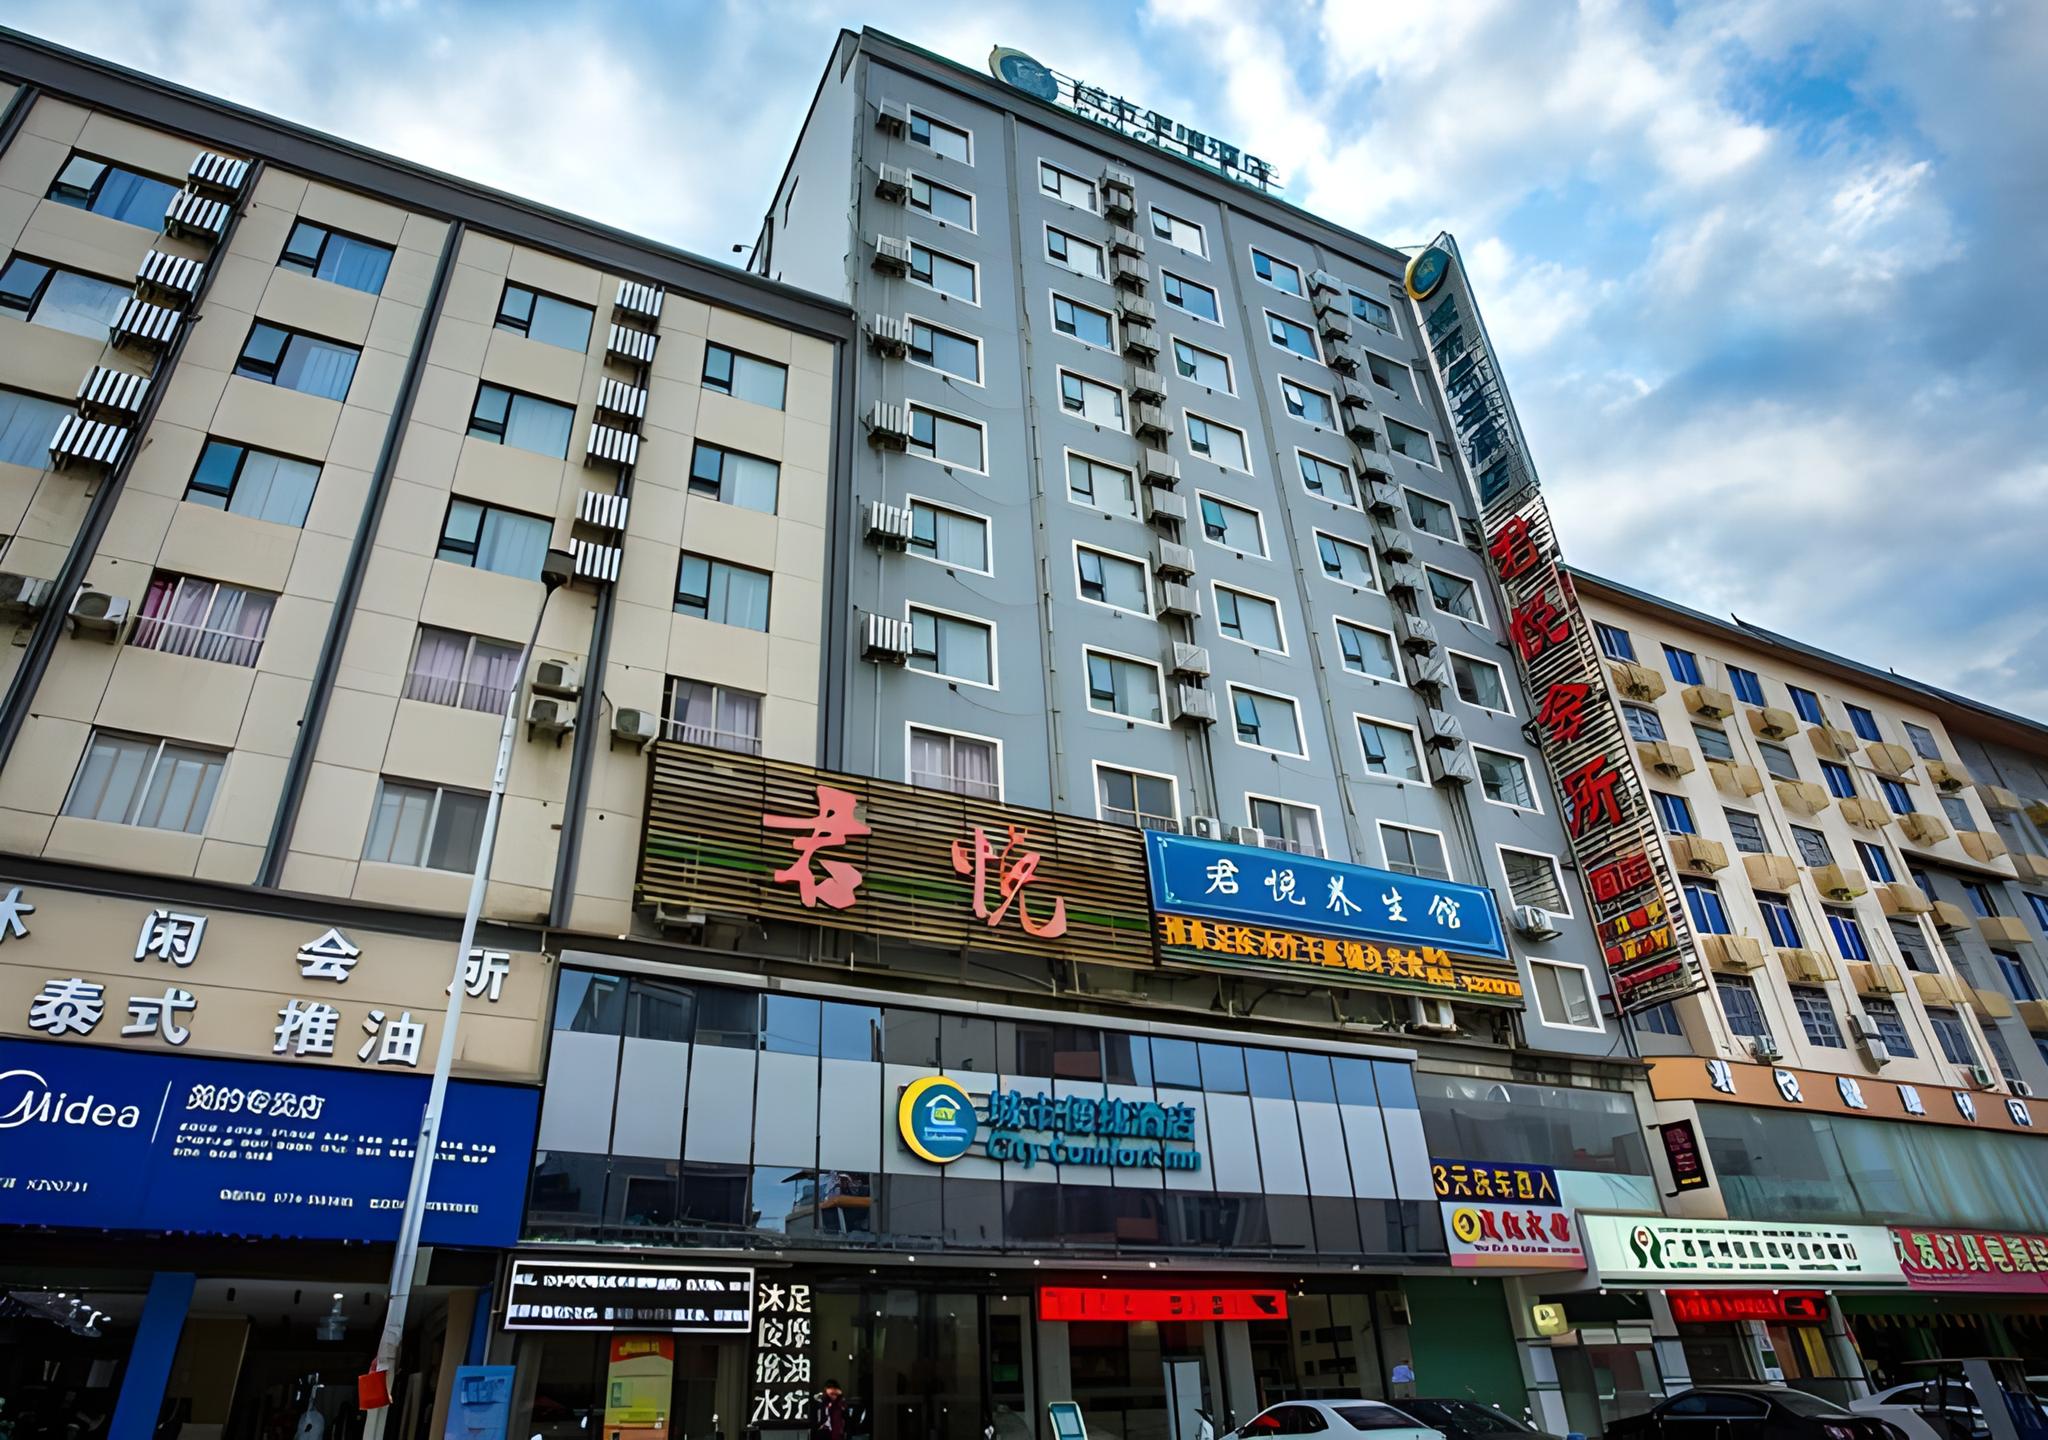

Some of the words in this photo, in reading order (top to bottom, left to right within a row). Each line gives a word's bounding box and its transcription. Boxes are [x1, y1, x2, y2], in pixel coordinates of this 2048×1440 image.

[1205, 858, 1461, 929] 君悦养生馆
[6, 1084, 140, 1128] Midea
